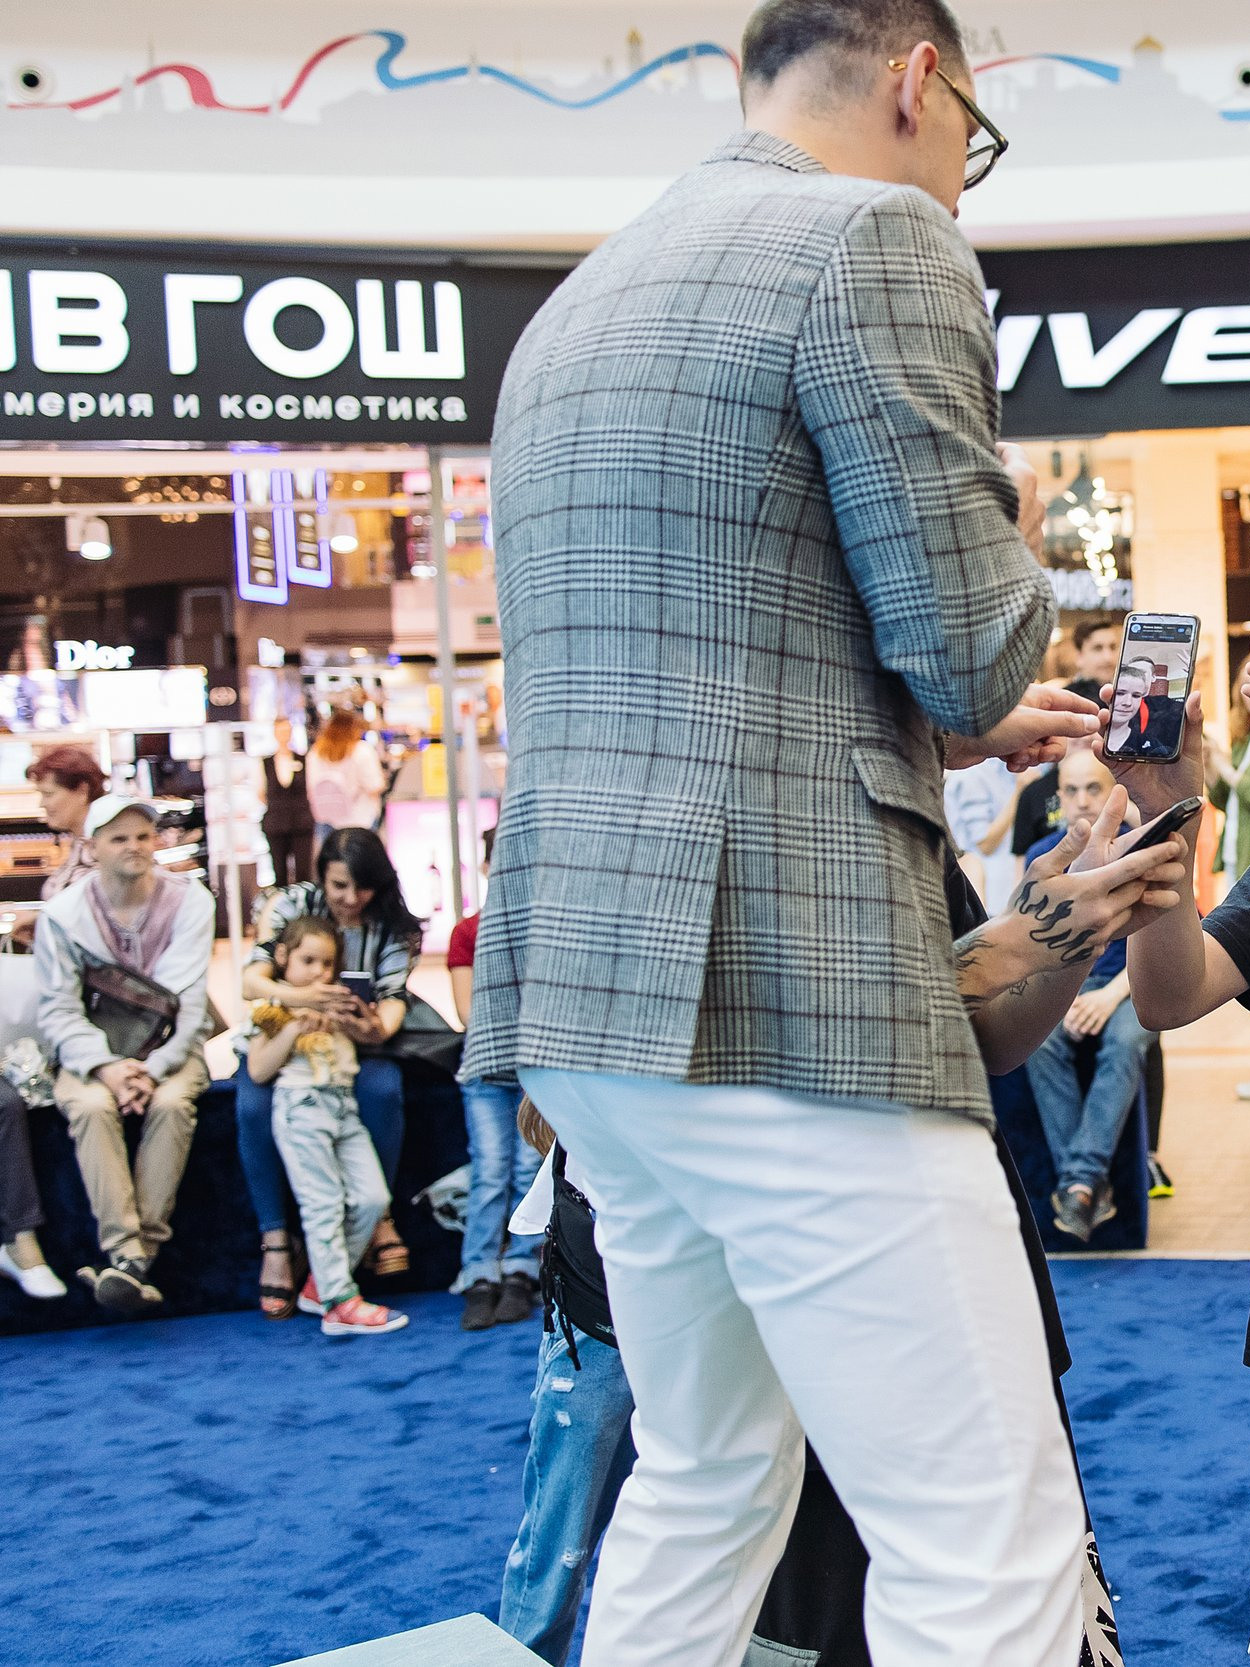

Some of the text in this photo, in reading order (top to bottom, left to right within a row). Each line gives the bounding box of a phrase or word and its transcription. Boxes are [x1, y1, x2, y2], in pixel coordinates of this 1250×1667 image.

[0, 268, 466, 379] В ГОШ
[173, 393, 200, 418] и
[220, 393, 468, 422] косметика
[54, 639, 135, 671] Dior
